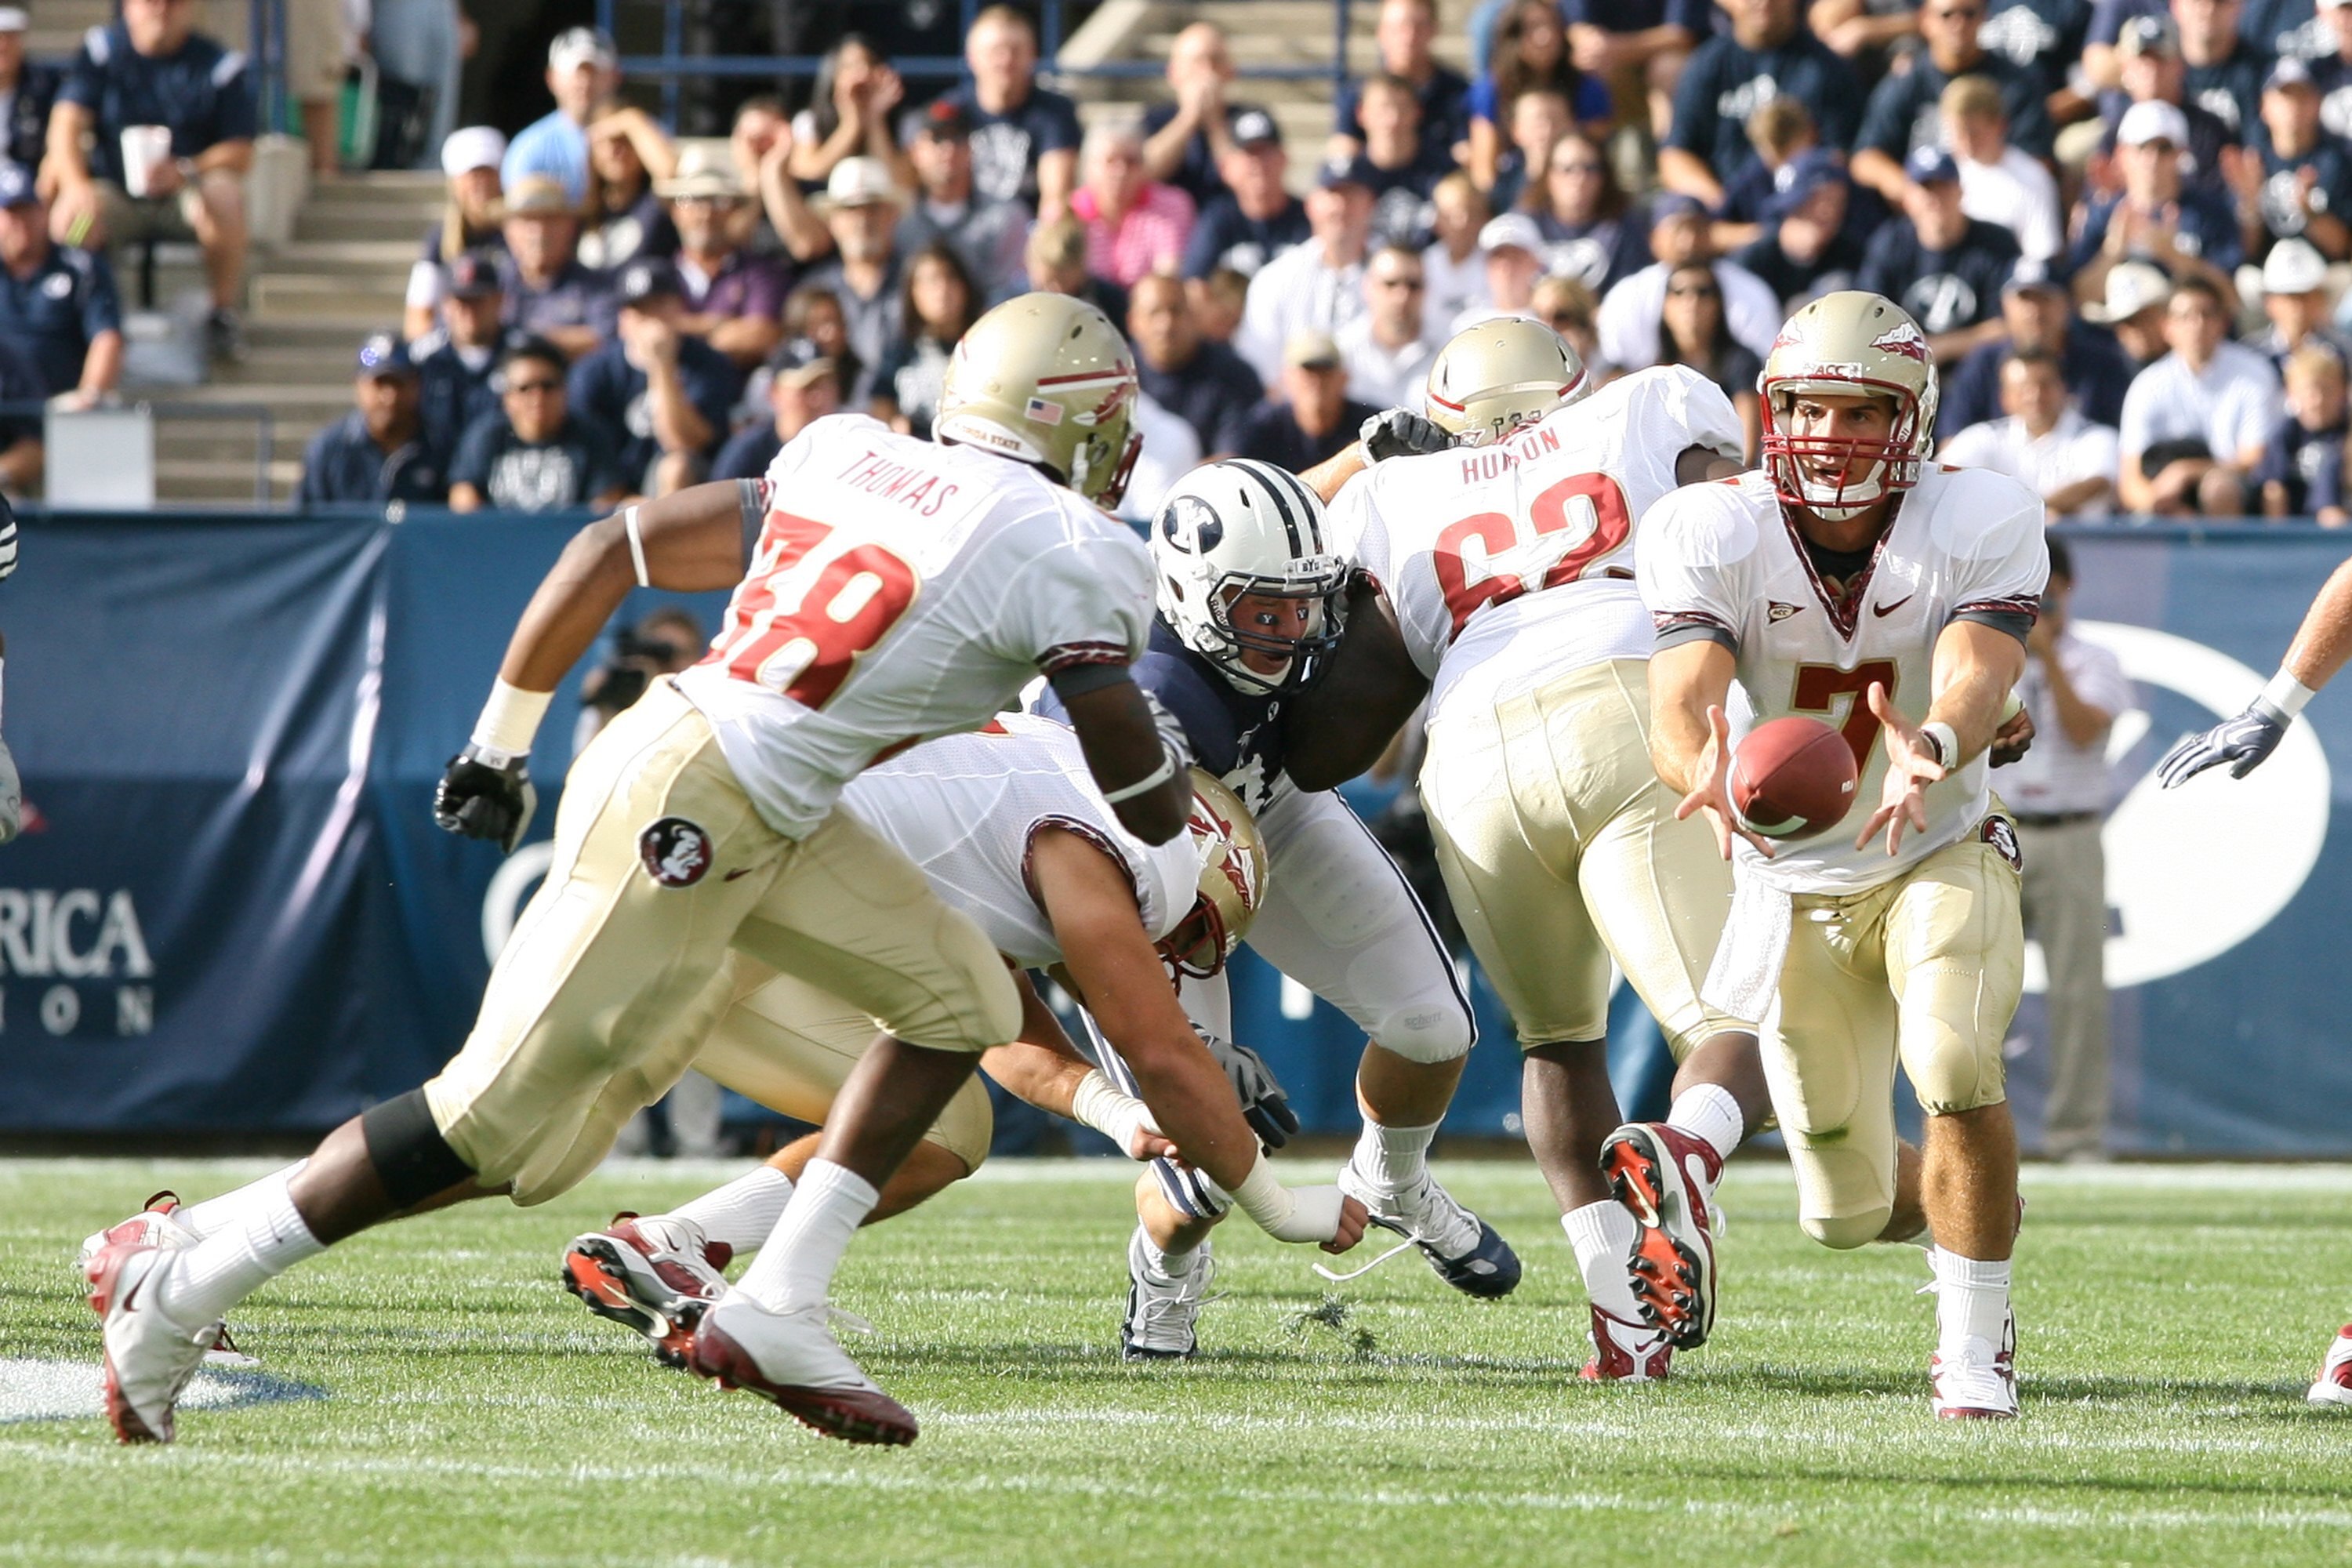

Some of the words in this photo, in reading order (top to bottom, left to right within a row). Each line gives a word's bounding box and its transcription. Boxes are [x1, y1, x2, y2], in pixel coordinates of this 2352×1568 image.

[1814, 364, 1846, 376] ACC
[837, 450, 959, 517] THOMAS
[1301, 558, 1321, 572] BYU
[1433, 471, 1634, 646] 62
[693, 508, 924, 711] 78
[1262, 614, 1273, 624] Y
[1788, 656, 1900, 792] 7
